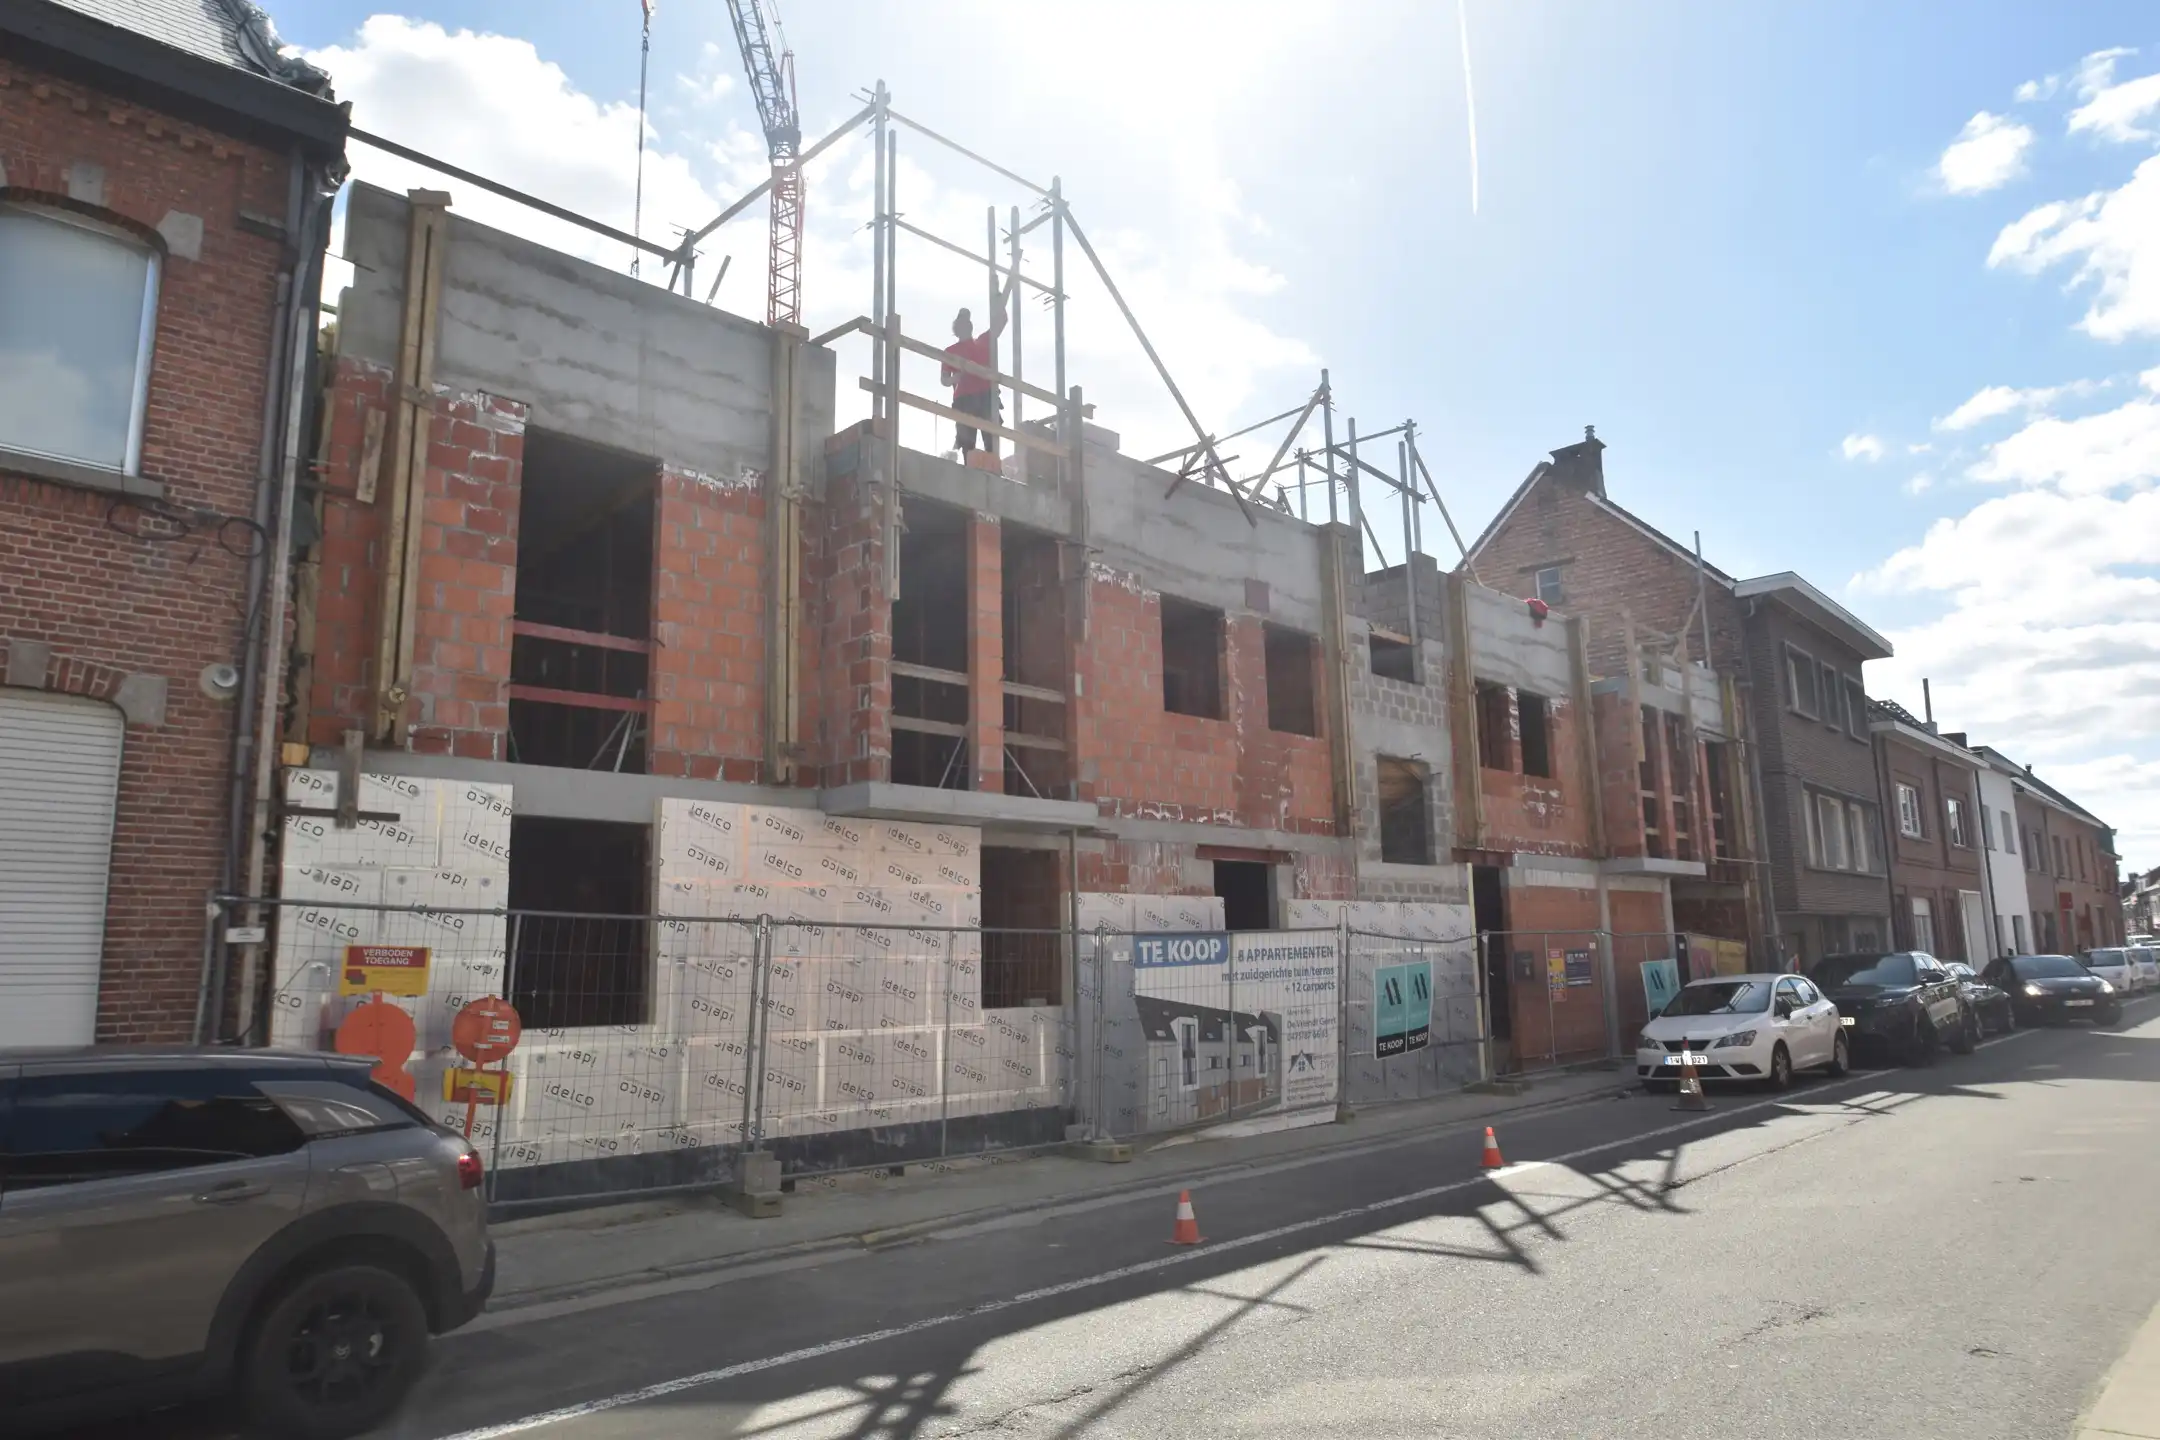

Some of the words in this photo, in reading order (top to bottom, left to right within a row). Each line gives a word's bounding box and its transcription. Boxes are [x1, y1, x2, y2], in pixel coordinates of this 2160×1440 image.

[467, 790, 513, 817] delco
[691, 802, 732, 831] idelco
[765, 817, 804, 844] idelco
[824, 818, 860, 843] idelco
[888, 827, 922, 850] idelco
[937, 833, 969, 856] idelco
[687, 847, 730, 876] idelco
[763, 850, 803, 877] idelco
[821, 858, 859, 884] idelco
[938, 864, 970, 886] idelco
[857, 891, 892, 914] idelco
[910, 891, 942, 912] idelco
[298, 909, 359, 938] idelco
[363, 948, 413, 957] VERBODEN
[364, 957, 410, 966] TOEGANG
[1138, 940, 1164, 964] TE
[1167, 938, 1222, 963] KOOP
[1246, 946, 1334, 962] APPARTEMENTEN
[827, 982, 863, 1004] idelco
[882, 977, 916, 999] idelco
[1292, 982, 1301, 994] 12
[1303, 981, 1335, 994] carports
[692, 999, 735, 1025] idelco
[839, 1045, 875, 1065] idelco
[894, 1038, 928, 1058] idelco
[954, 1064, 987, 1082] idelco
[1002, 1057, 1032, 1076] idelco
[545, 1081, 595, 1106] idelco
[620, 1081, 666, 1105] idelco
[704, 1072, 746, 1096] idelco
[767, 1072, 806, 1096] idelco
[838, 1081, 875, 1101] idelco
[892, 1078, 926, 1097] idelco
